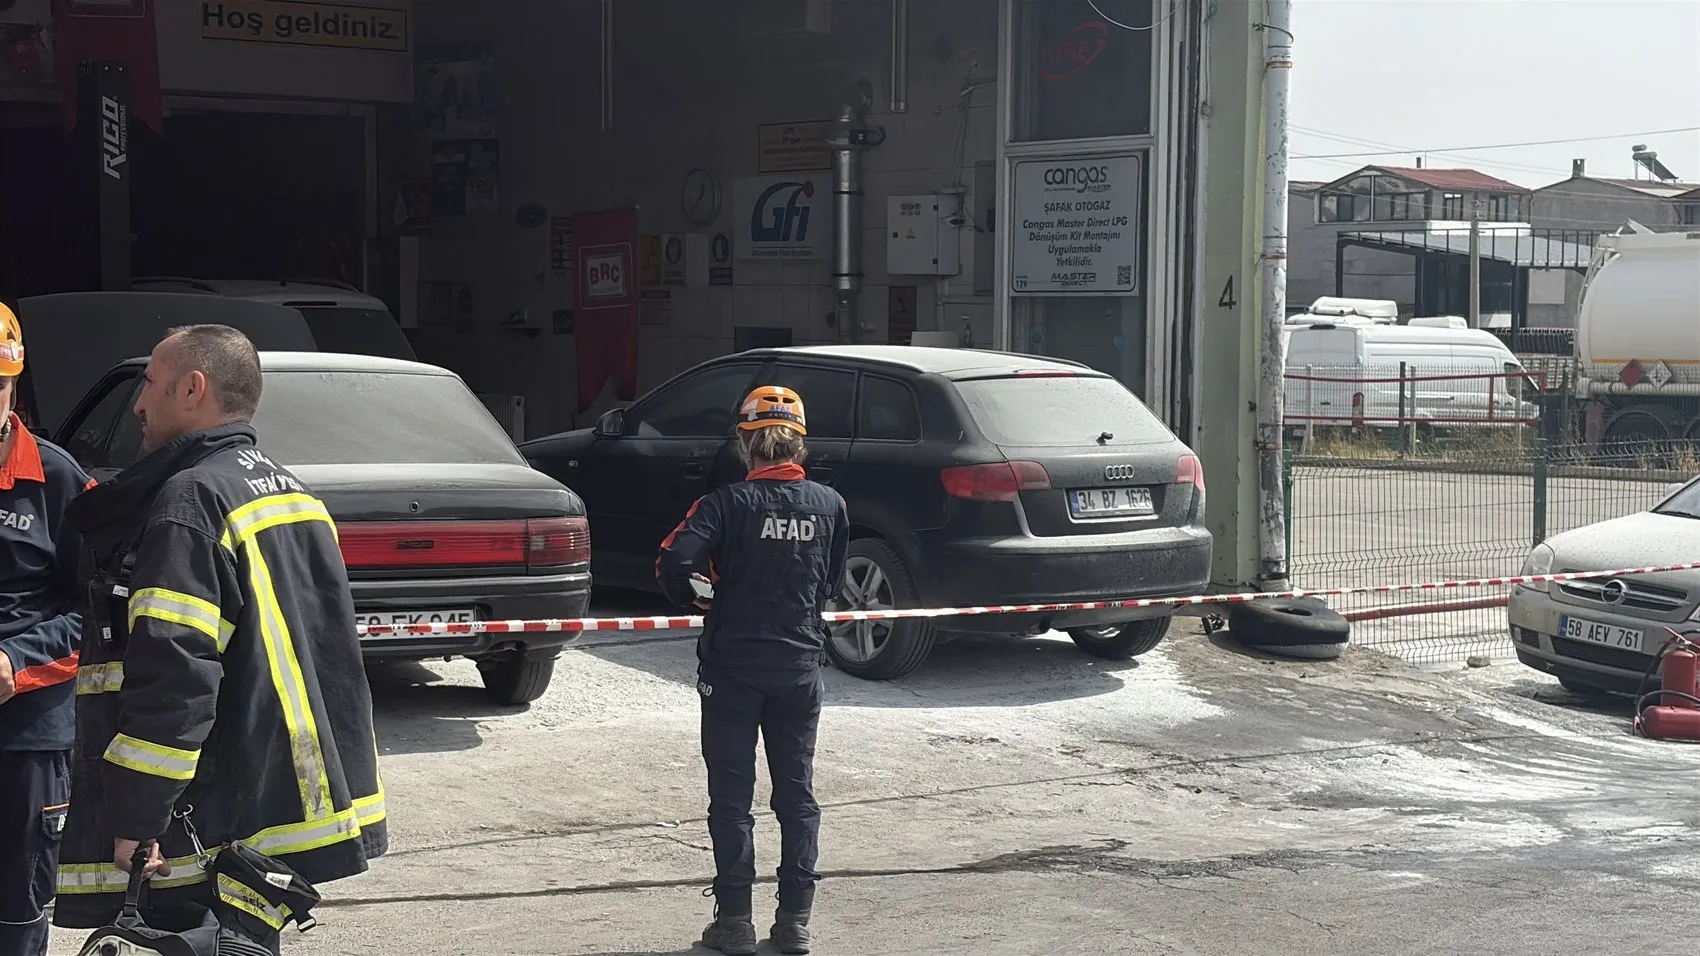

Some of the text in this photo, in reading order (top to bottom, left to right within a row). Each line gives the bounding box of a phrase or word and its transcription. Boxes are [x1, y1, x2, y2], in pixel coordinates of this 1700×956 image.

[203, 3, 400, 40] Hoş geldiniz
[102, 95, 127, 180] RICO
[1044, 166, 1109, 193] cangas
[1044, 201, 1111, 215] ŞAFAK OTOGAZ
[1056, 218, 1085, 229] Master
[1086, 217, 1110, 227] Direct
[1111, 216, 1128, 227] LPG
[1029, 231, 1068, 242] Dönüşüm
[1070, 230, 1082, 241] Kit
[1048, 243, 1102, 256] Uygulamakla
[589, 262, 620, 285] BRC
[1051, 272, 1097, 281] MASTER
[1218, 274, 1237, 310] 4
[1078, 491, 1096, 511] 34
[1101, 490, 1119, 509] BZ
[0, 509, 31, 531] FAD
[760, 517, 815, 541] AFAD
[1568, 620, 1638, 648] 58 AEV 761
